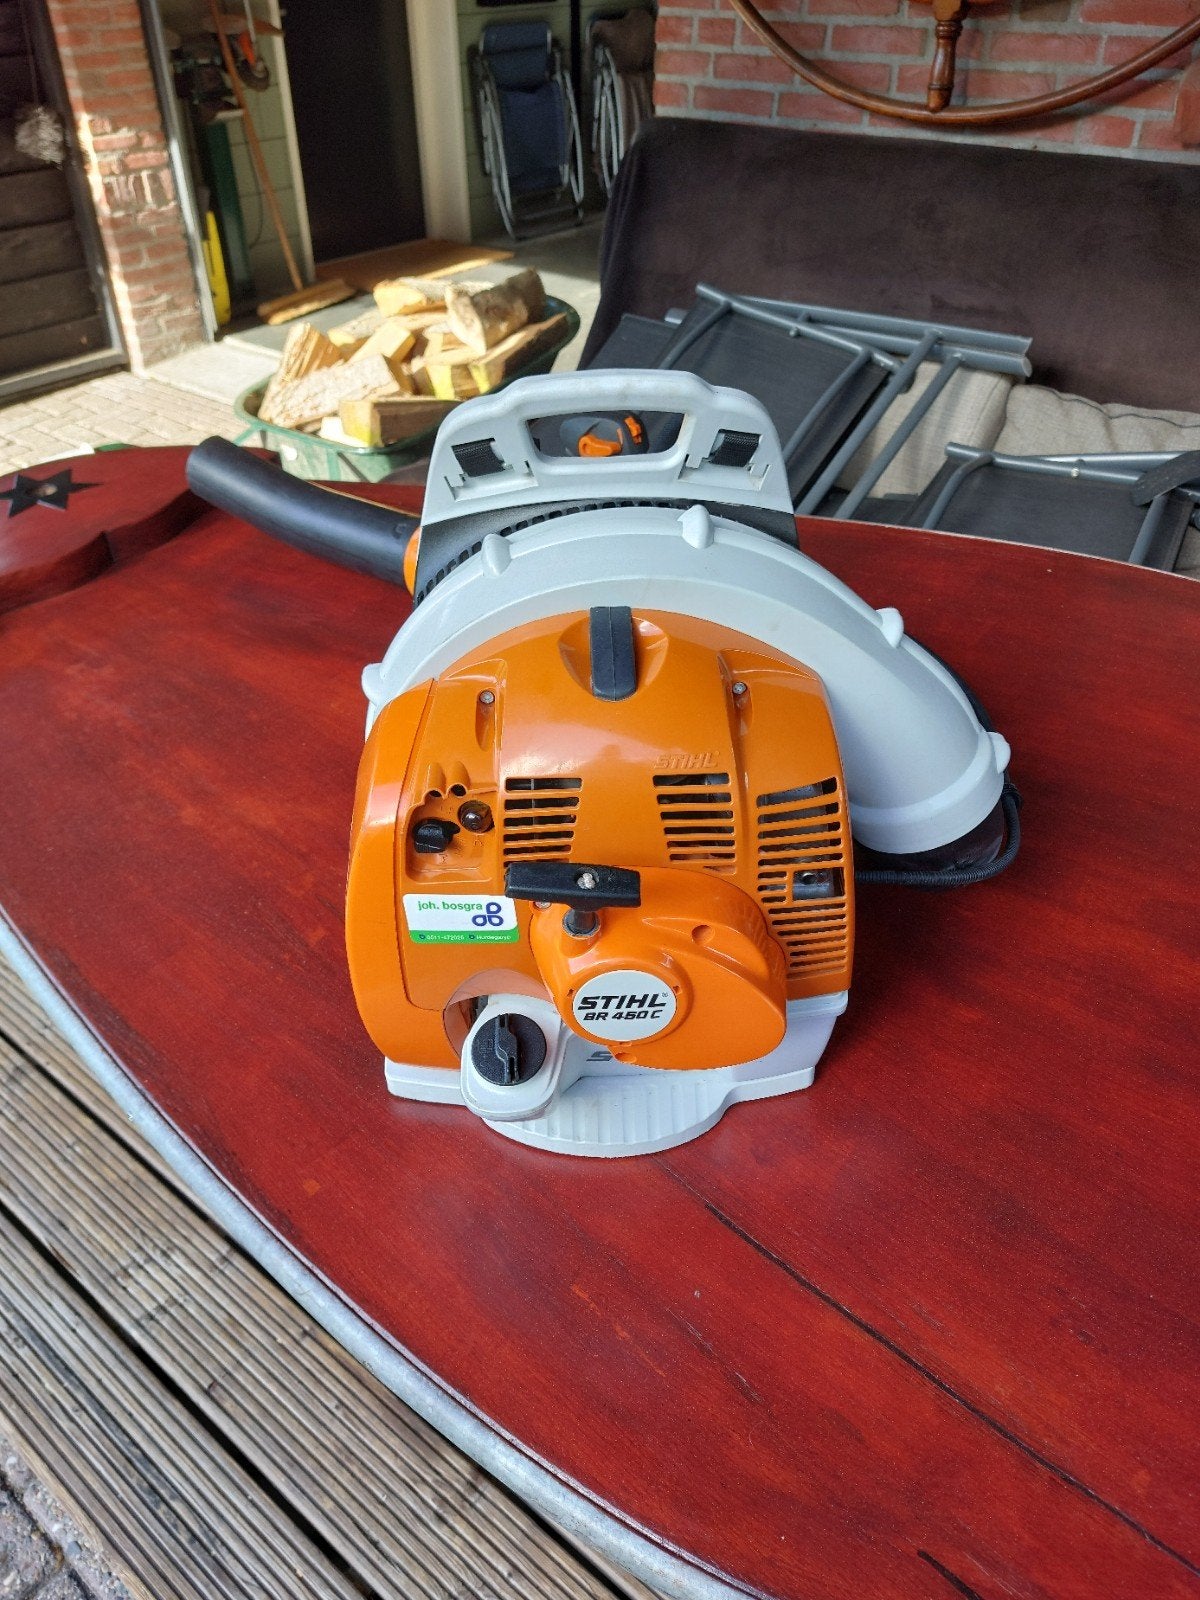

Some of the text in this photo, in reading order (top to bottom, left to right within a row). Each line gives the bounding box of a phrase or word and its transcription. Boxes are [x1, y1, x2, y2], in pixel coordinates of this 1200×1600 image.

[653, 752, 718, 769] STIHL
[418, 901, 483, 912] joh. bosgra
[583, 1011, 609, 1021] BR
[650, 1009, 663, 1019] C
